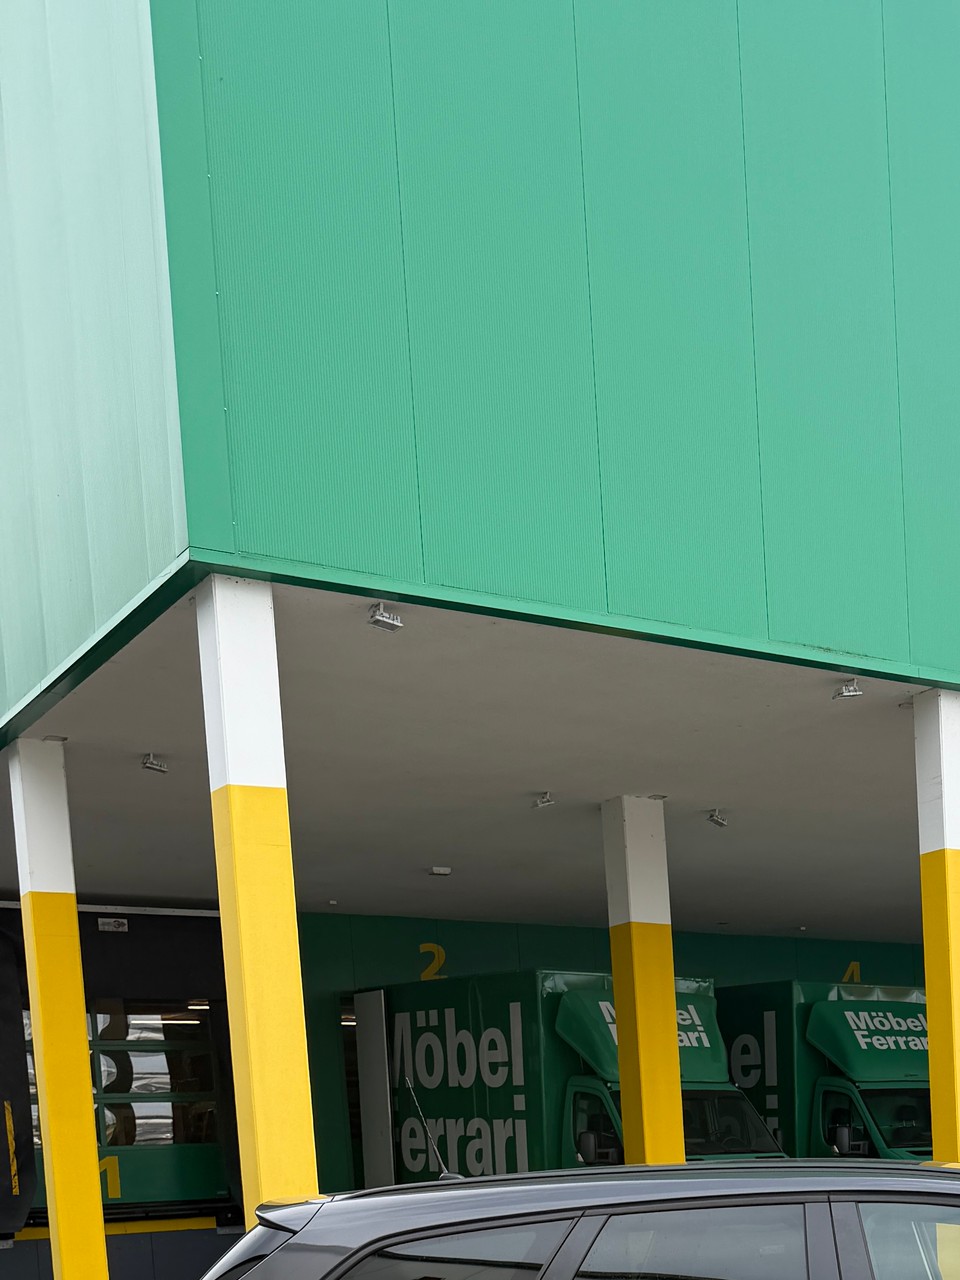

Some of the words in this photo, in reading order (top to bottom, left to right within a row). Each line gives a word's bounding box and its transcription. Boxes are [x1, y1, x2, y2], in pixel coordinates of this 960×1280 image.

[419, 943, 449, 981] 2
[844, 1011, 929, 1032] Möbel
[853, 1030, 929, 1051] Ferrar
[395, 1094, 529, 1176] errari
[99, 1155, 122, 1199] 1
